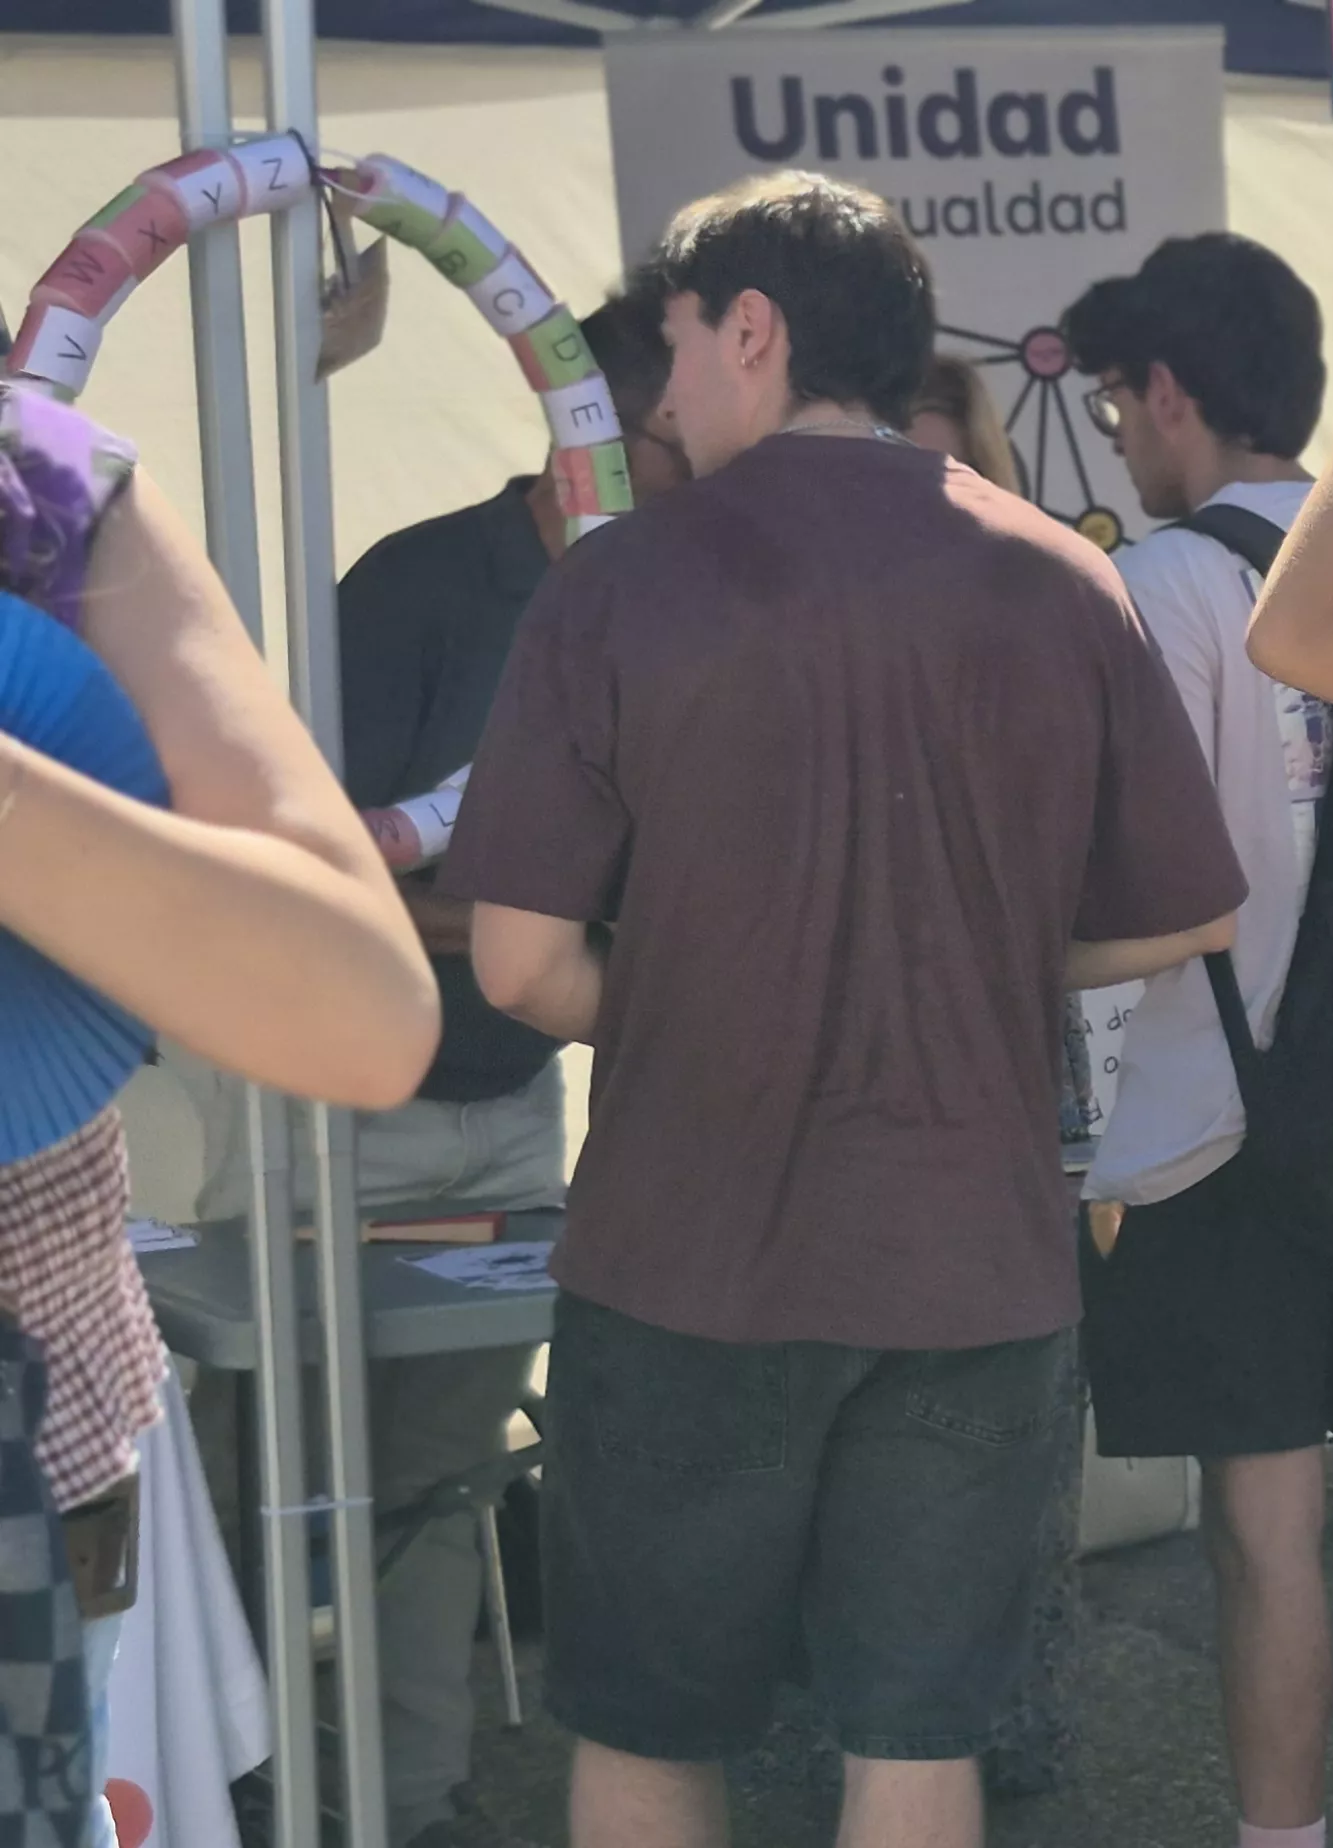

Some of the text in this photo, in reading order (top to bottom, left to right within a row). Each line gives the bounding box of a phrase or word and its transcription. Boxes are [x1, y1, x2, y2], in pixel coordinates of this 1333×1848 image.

[729, 64, 1121, 163] Unidad
[261, 157, 289, 191] Z
[201, 182, 223, 215] Y
[137, 220, 168, 254] X
[492, 287, 525, 318] C
[551, 332, 581, 363] D
[570, 401, 605, 429] E
